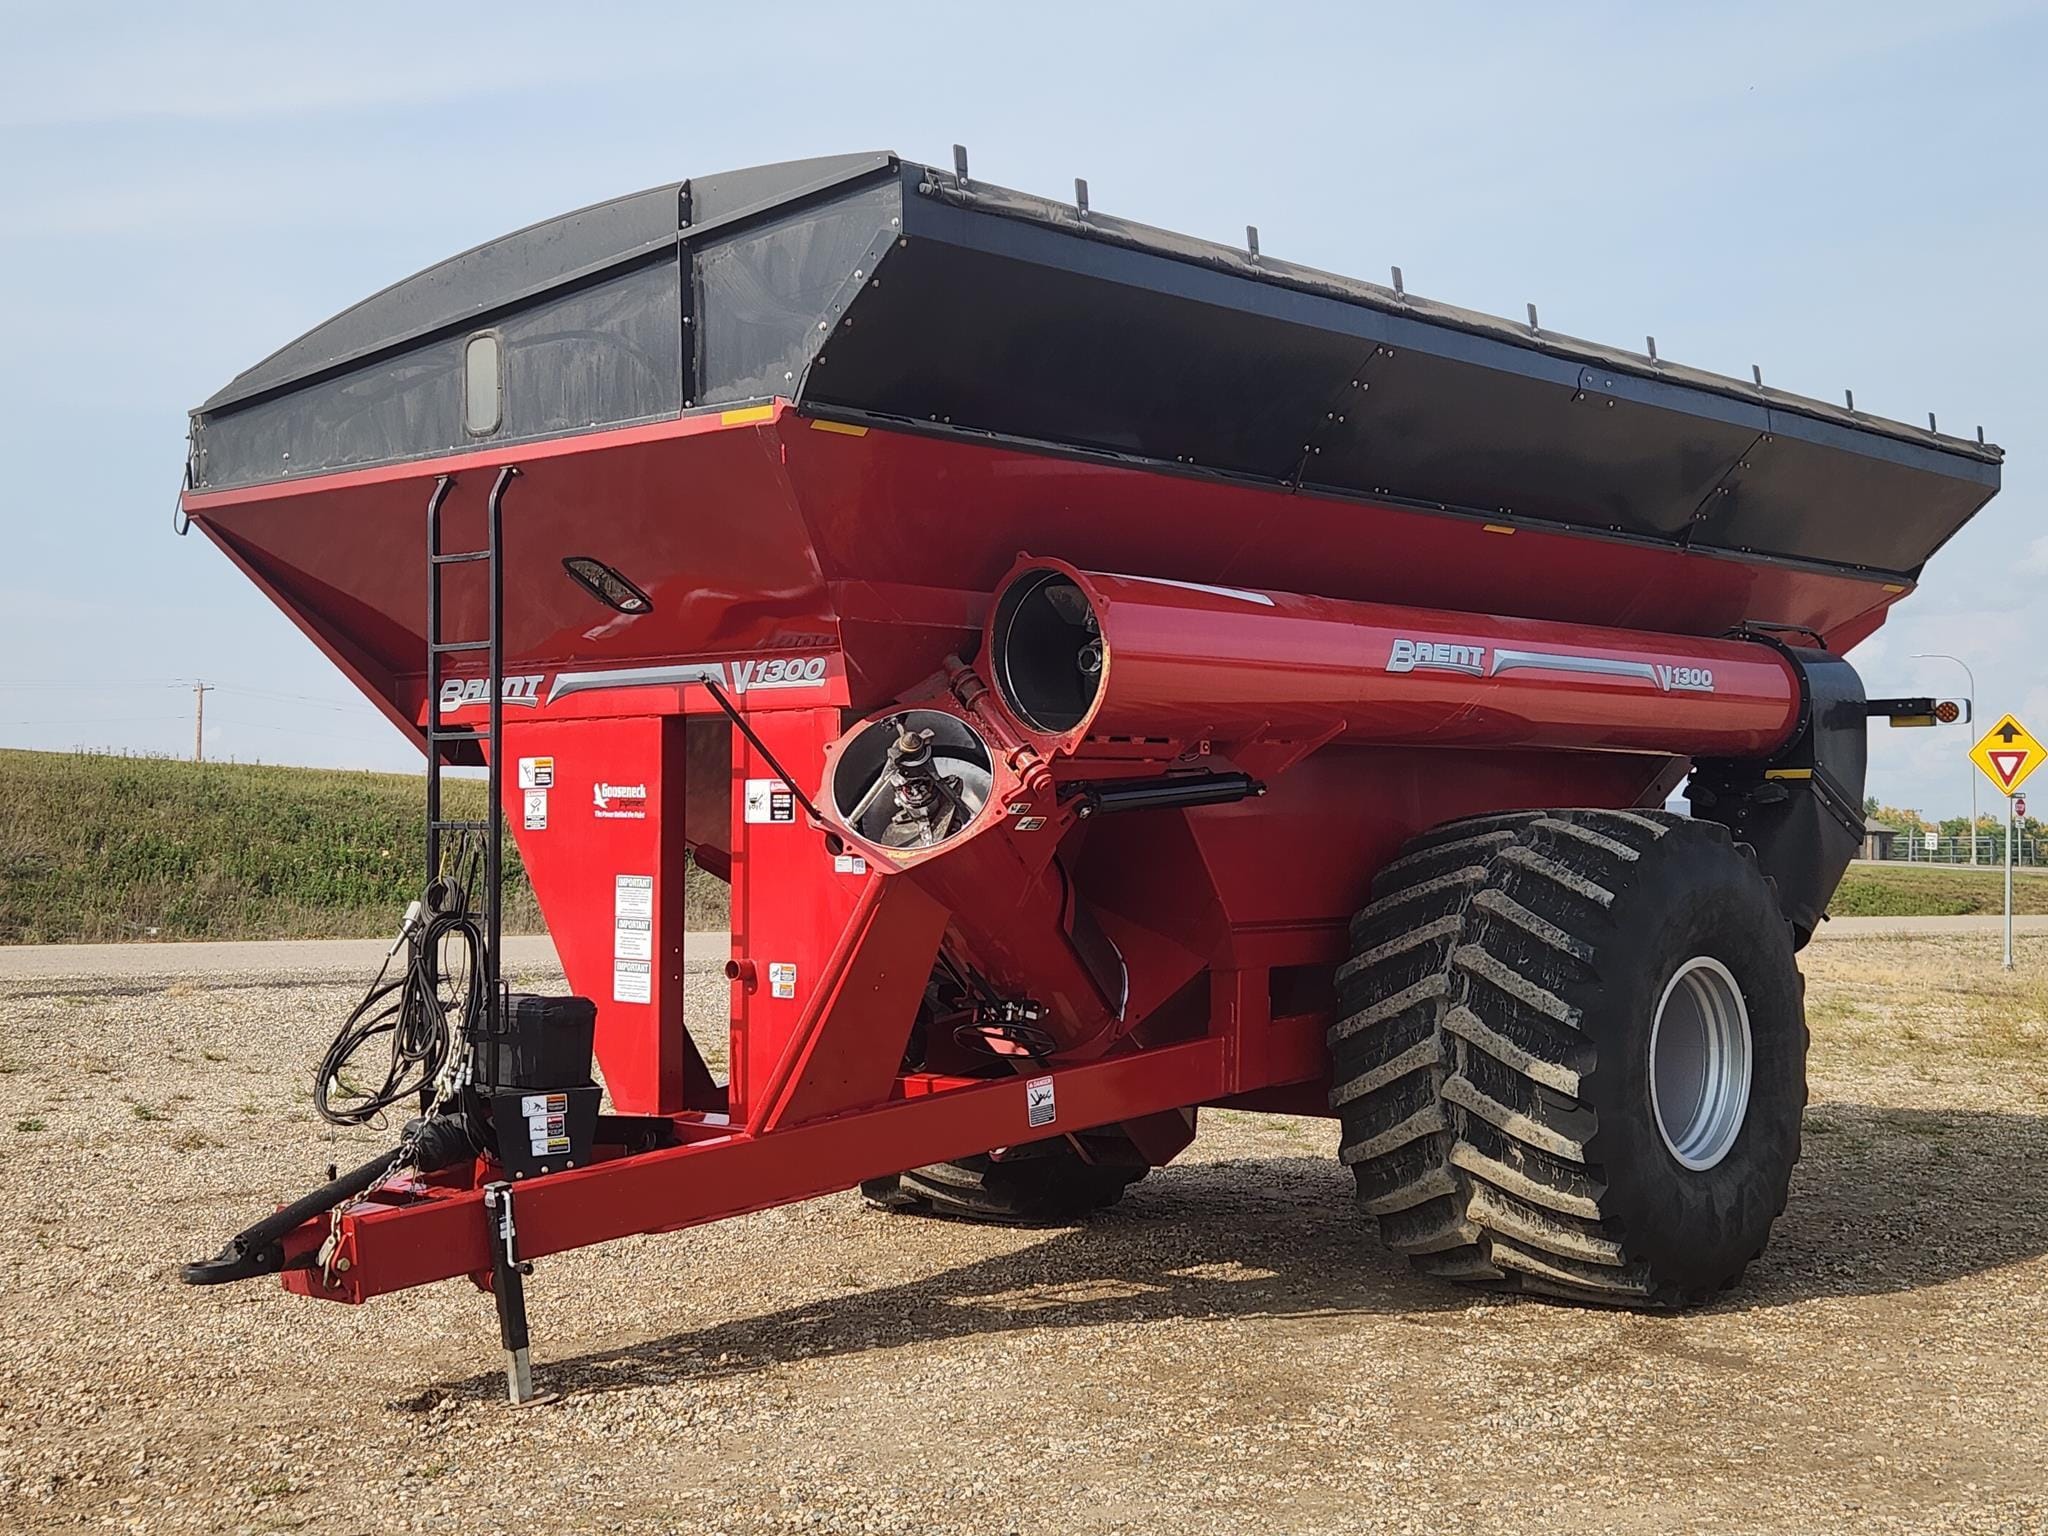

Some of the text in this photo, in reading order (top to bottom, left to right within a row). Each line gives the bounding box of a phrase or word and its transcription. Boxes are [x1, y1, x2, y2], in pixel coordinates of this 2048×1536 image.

[1385, 638, 1713, 692] BRENT V1300
[730, 657, 826, 694] V1300
[601, 782, 647, 799] Gooseneck
[618, 878, 650, 888] IMPORTANT
[618, 919, 649, 930] IMPORTANT
[617, 961, 649, 973] IMPORTANT
